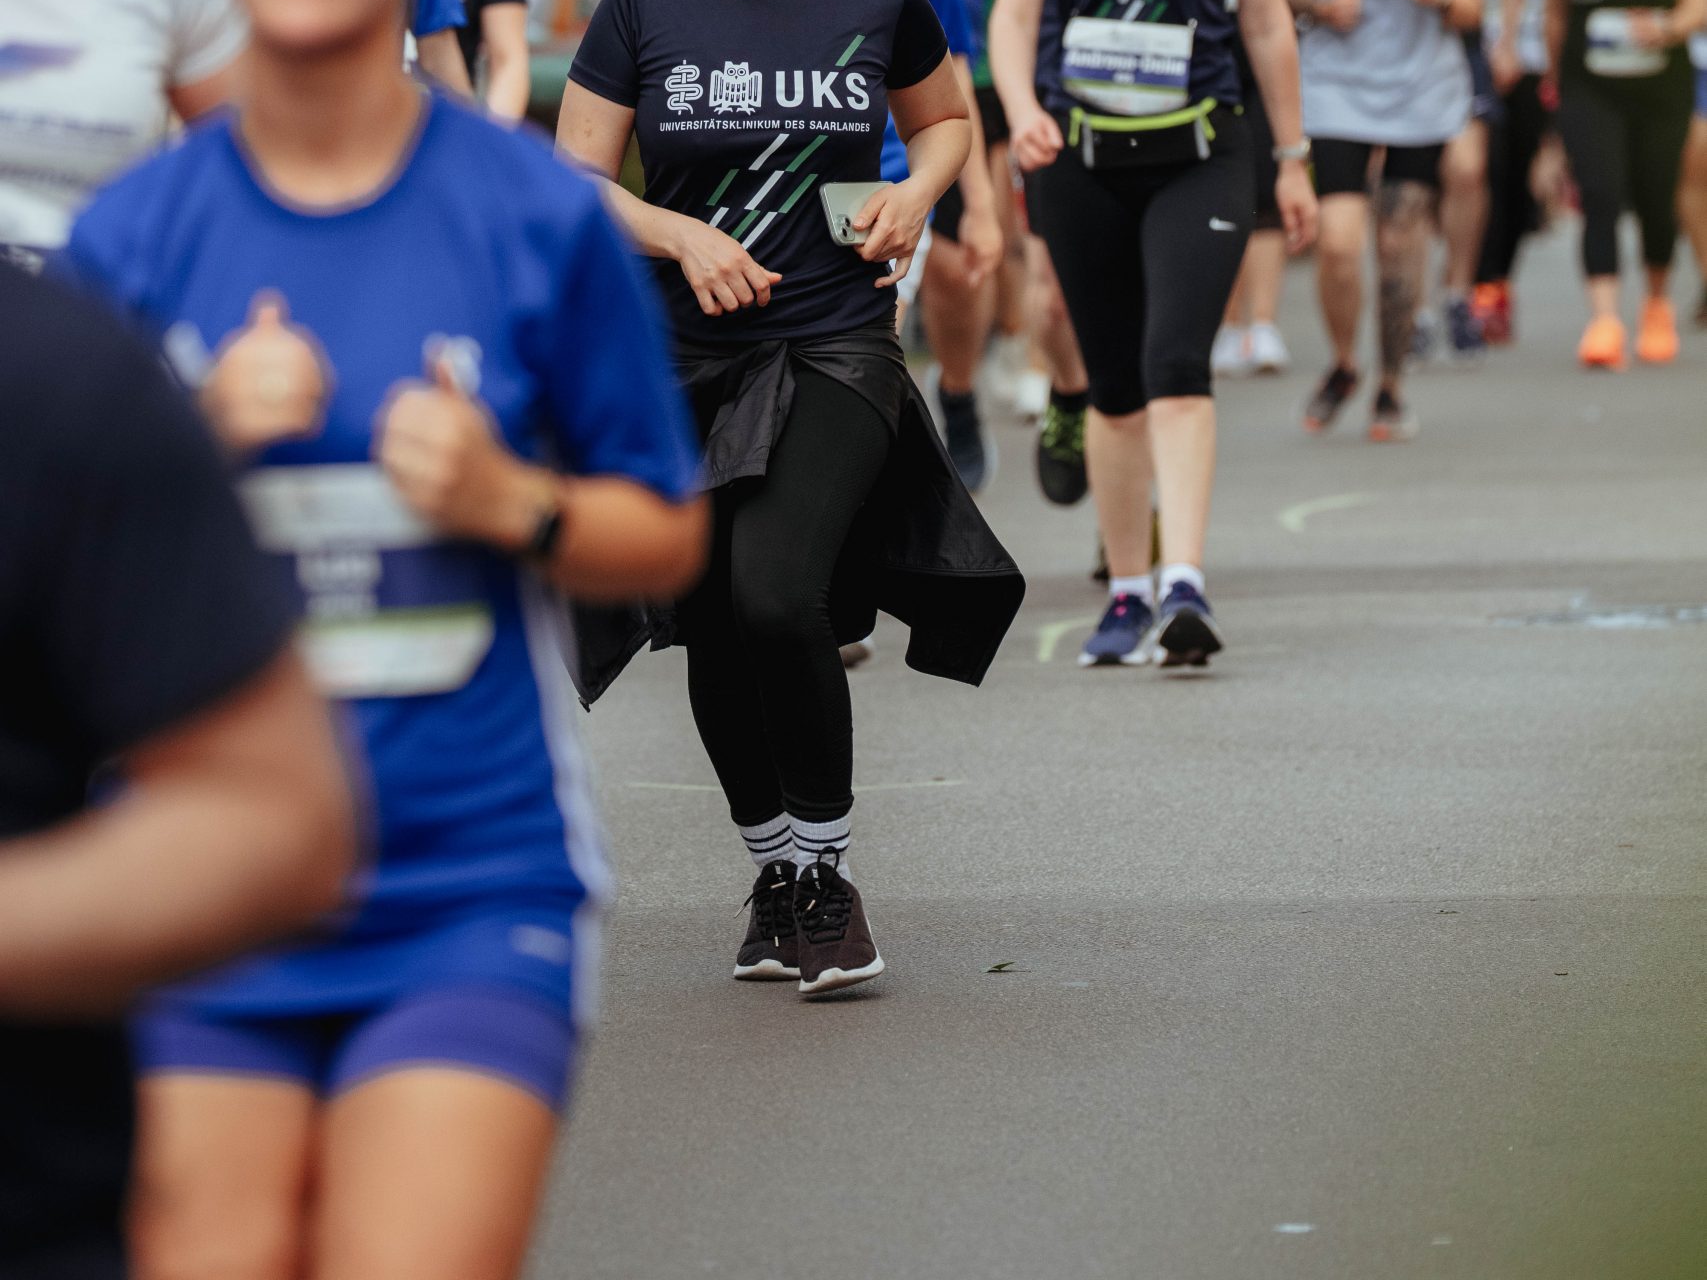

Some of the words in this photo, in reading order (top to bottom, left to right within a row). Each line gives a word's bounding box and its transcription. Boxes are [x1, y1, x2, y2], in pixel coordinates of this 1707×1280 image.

[775, 70, 870, 110] UKS
[659, 119, 780, 132] UNIVERSITÄTSKLINIKUM
[784, 120, 805, 130] DES
[809, 121, 870, 132] SAARLANDES
